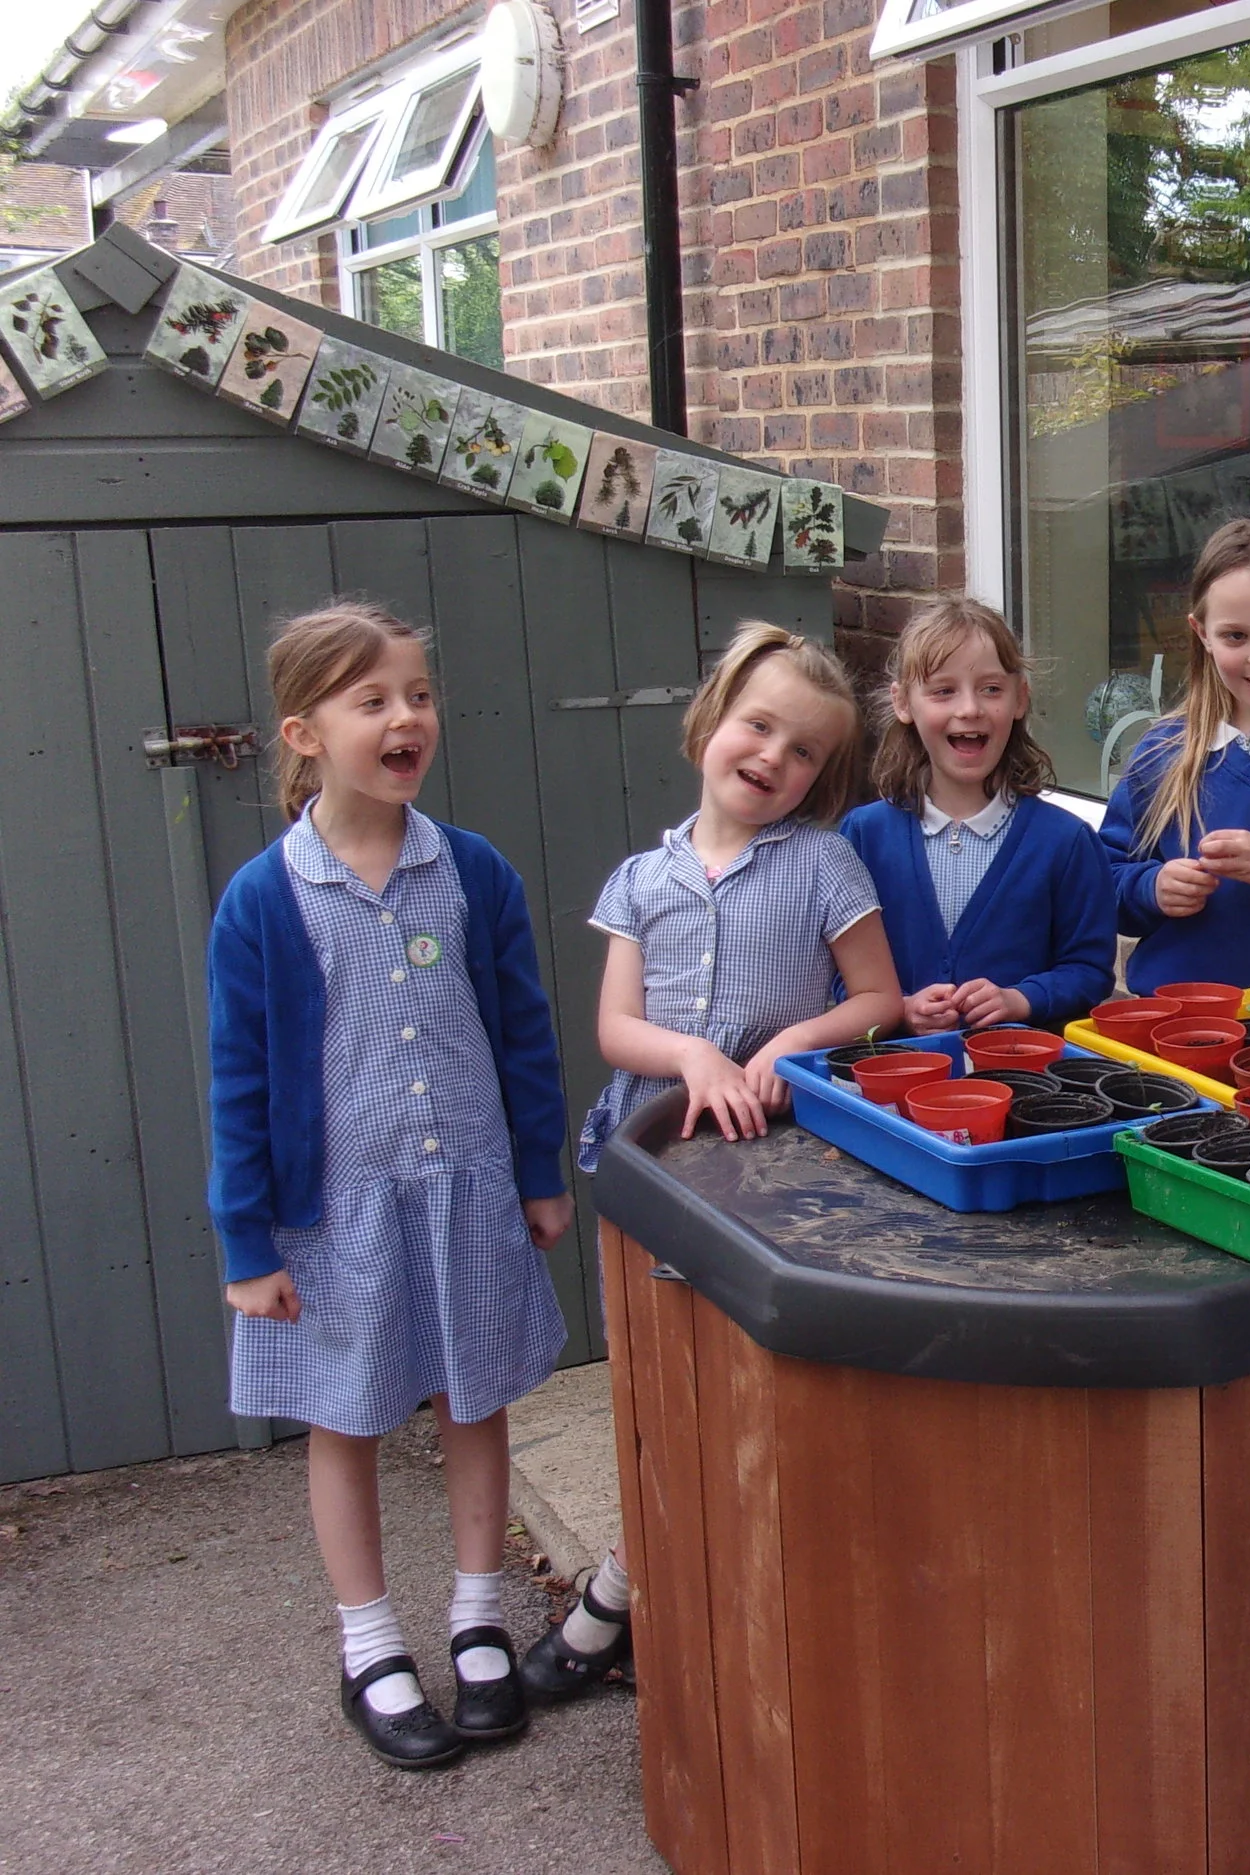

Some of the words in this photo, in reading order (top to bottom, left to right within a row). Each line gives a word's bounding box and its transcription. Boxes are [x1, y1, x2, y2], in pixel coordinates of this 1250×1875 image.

[326, 437, 338, 446] Ash
[395, 461, 413, 471] Alder
[457, 482, 471, 492] Crab
[471, 487, 488, 498] Apple
[602, 526, 618, 535] Larch
